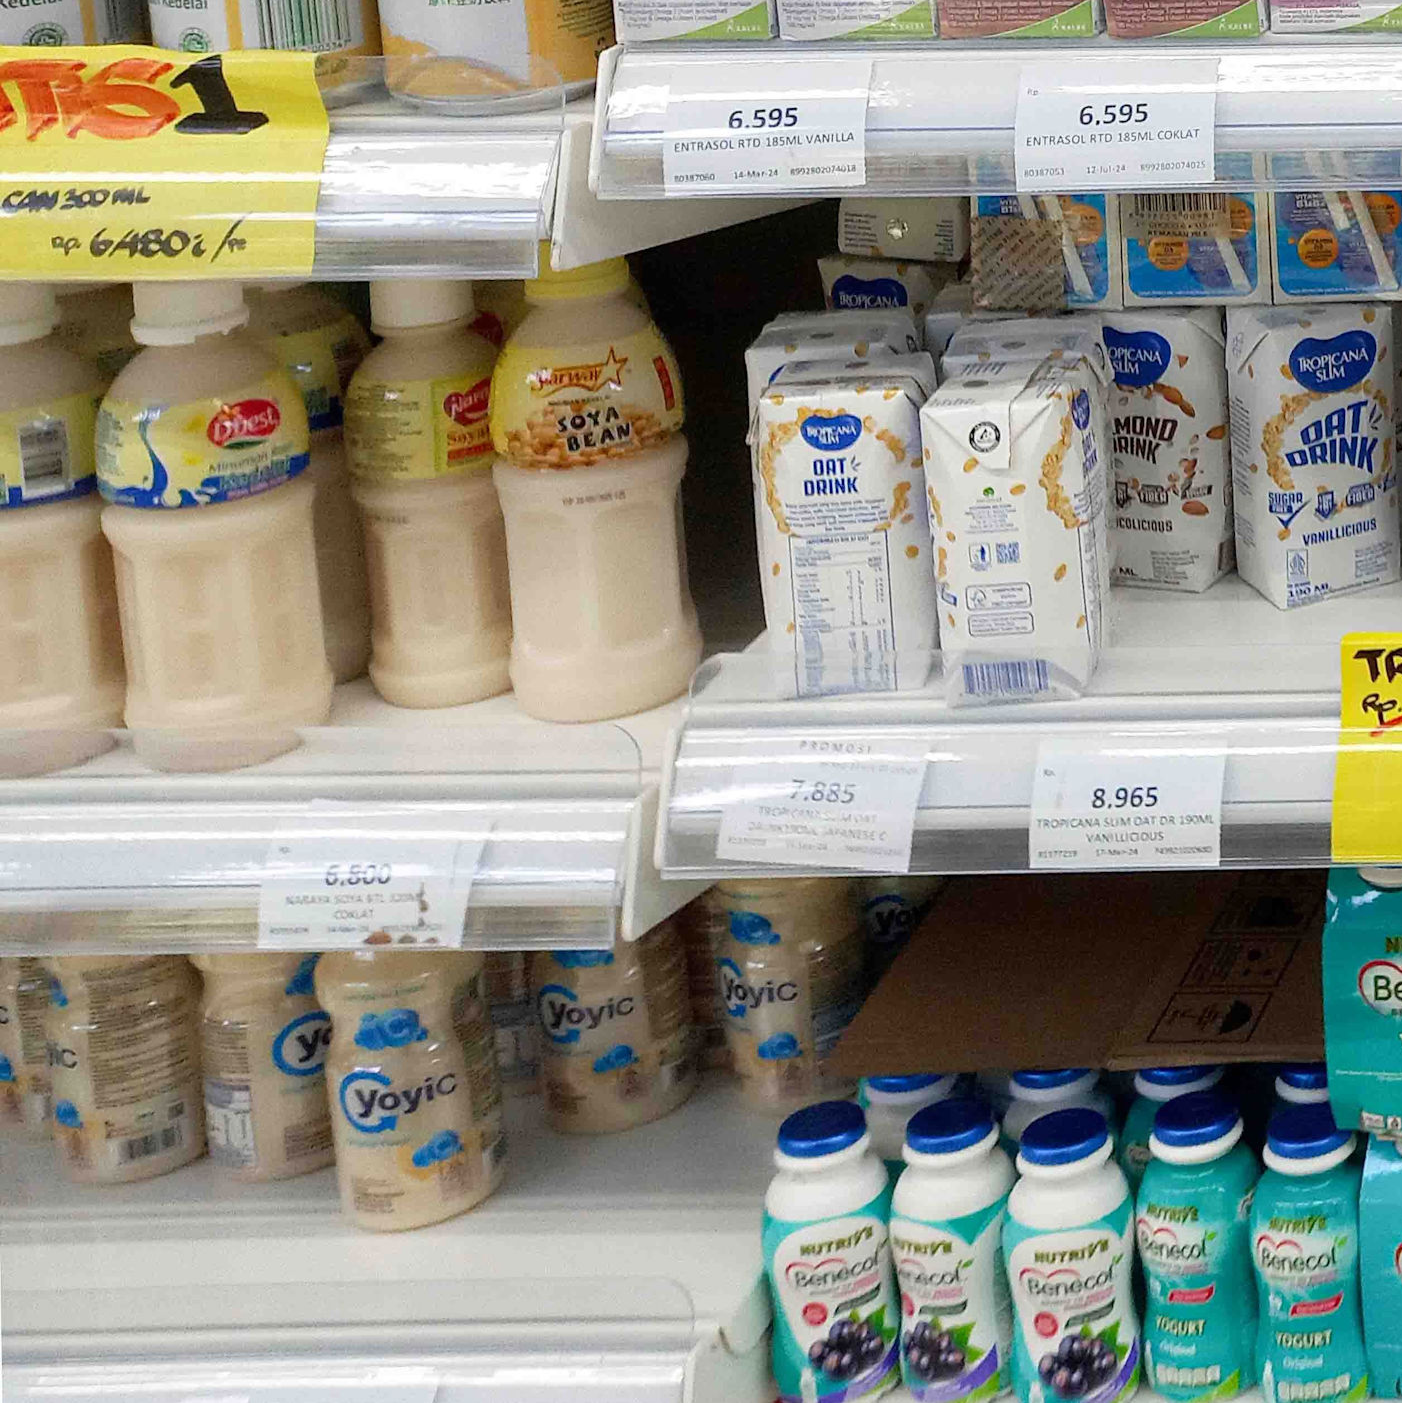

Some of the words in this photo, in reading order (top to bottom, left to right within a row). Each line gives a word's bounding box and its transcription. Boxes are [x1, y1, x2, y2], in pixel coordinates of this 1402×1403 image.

[169, 54, 269, 134] 1
[673, 138, 733, 153] ENTRASOL
[737, 137, 761, 151] RTD
[766, 135, 803, 149] 185ML
[806, 131, 855, 145] VANILLA
[556, 407, 620, 434] SOYA
[565, 423, 632, 453] BEAN
[1302, 517, 1377, 547] VANILLICIOUS
